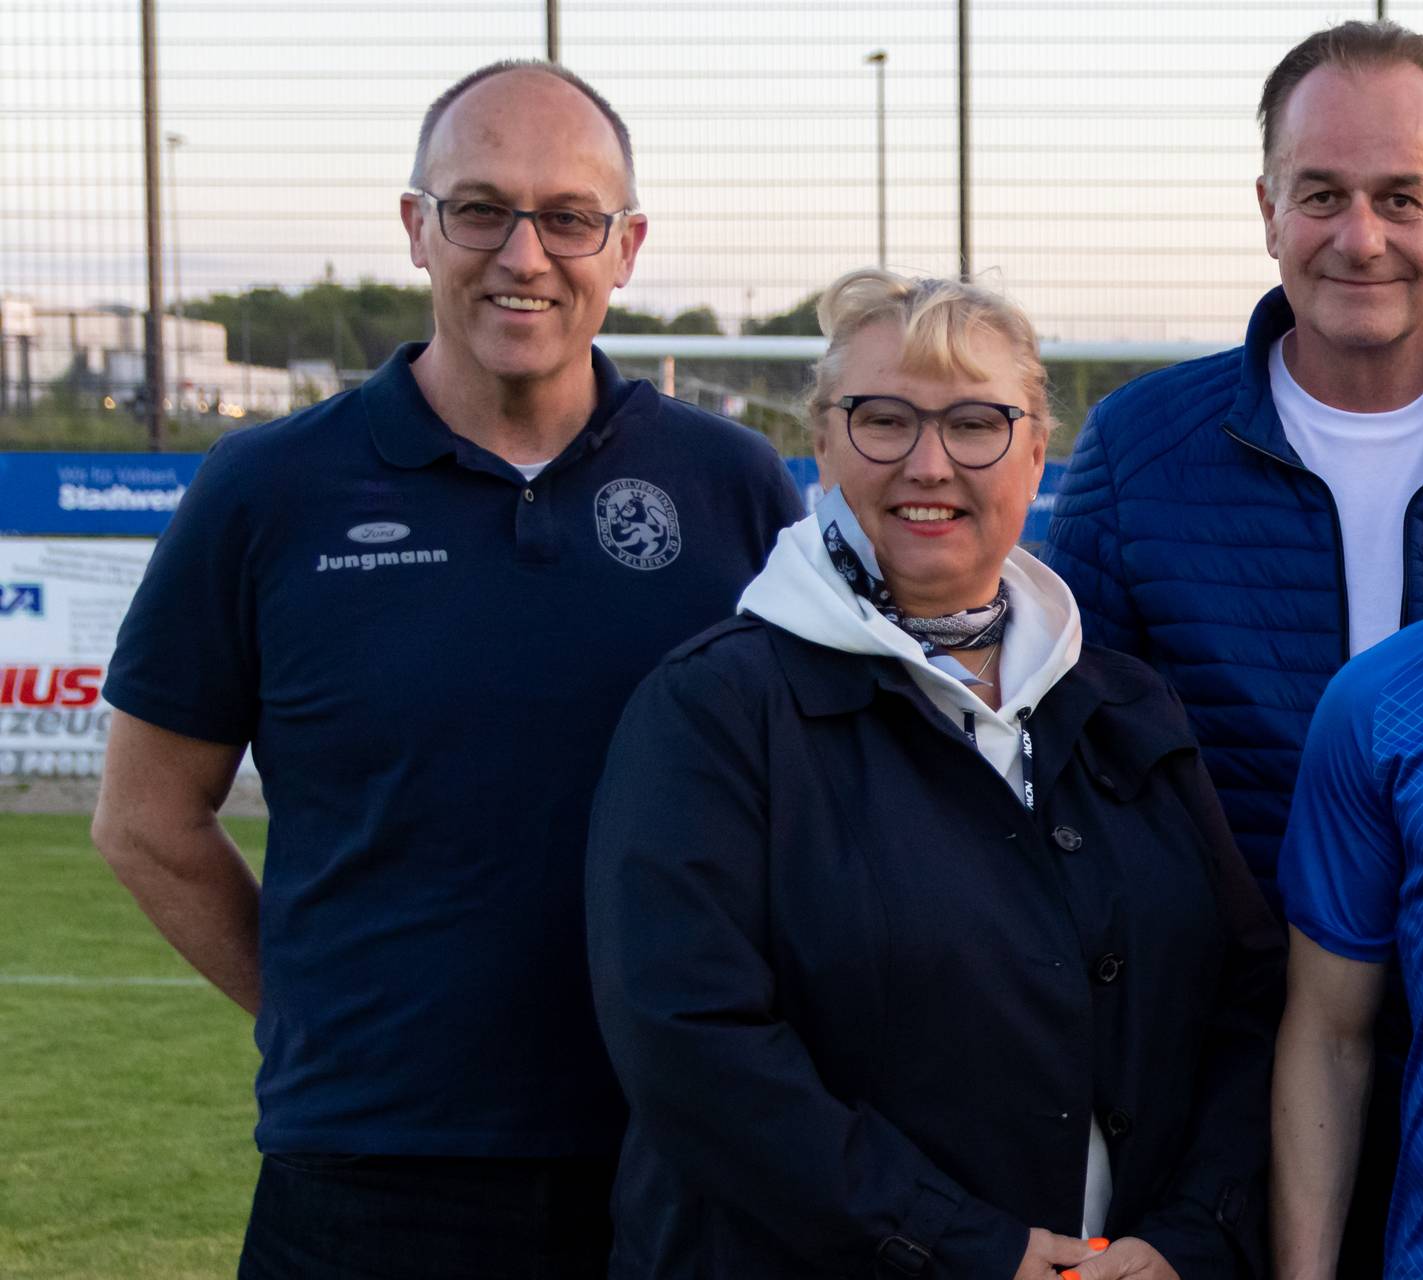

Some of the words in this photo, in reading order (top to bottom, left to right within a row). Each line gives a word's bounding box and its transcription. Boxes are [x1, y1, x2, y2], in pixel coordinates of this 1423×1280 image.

[360, 525, 396, 539] Ford
[316, 549, 449, 572] Jungmann
[618, 551, 668, 568] VELBERT
